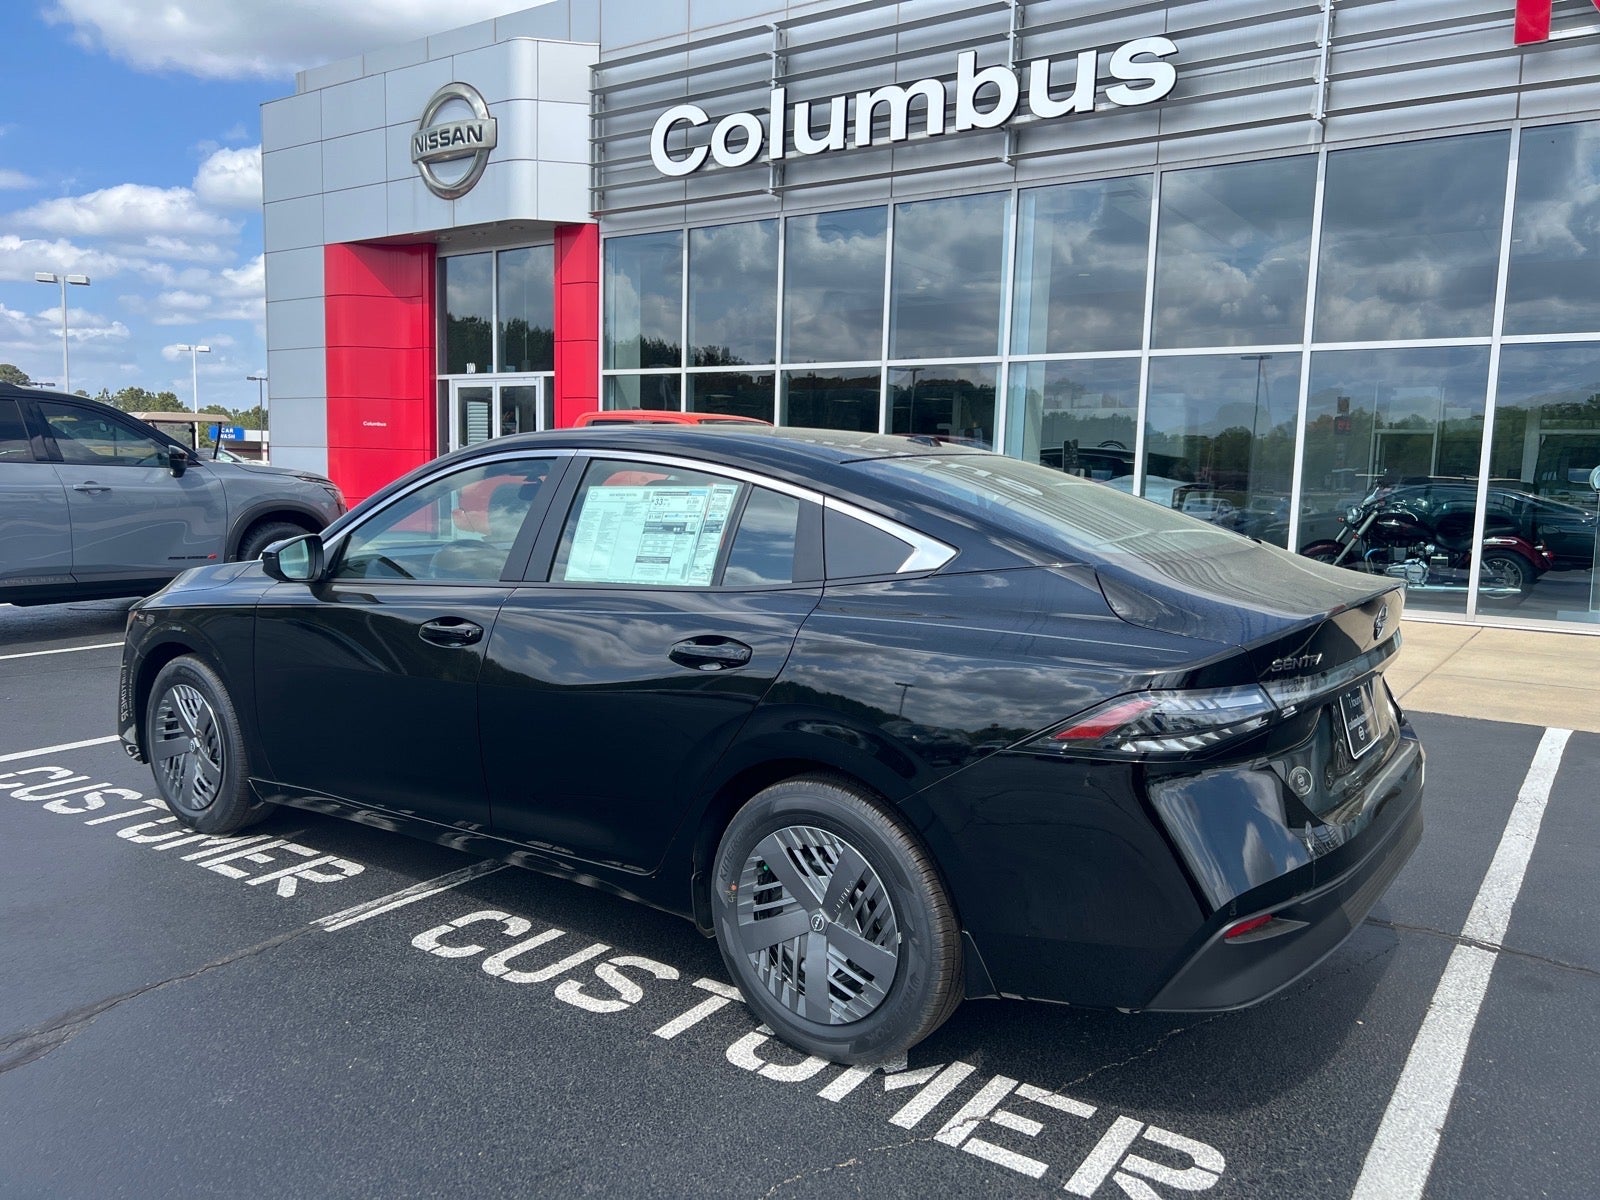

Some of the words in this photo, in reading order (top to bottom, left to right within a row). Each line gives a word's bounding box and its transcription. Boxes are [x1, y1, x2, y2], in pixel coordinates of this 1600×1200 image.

[414, 124, 483, 154] NISSAN
[650, 36, 1178, 177] Columbus
[0, 766, 366, 898] CUSTOMER
[411, 909, 1226, 1200] CUSTOMER
